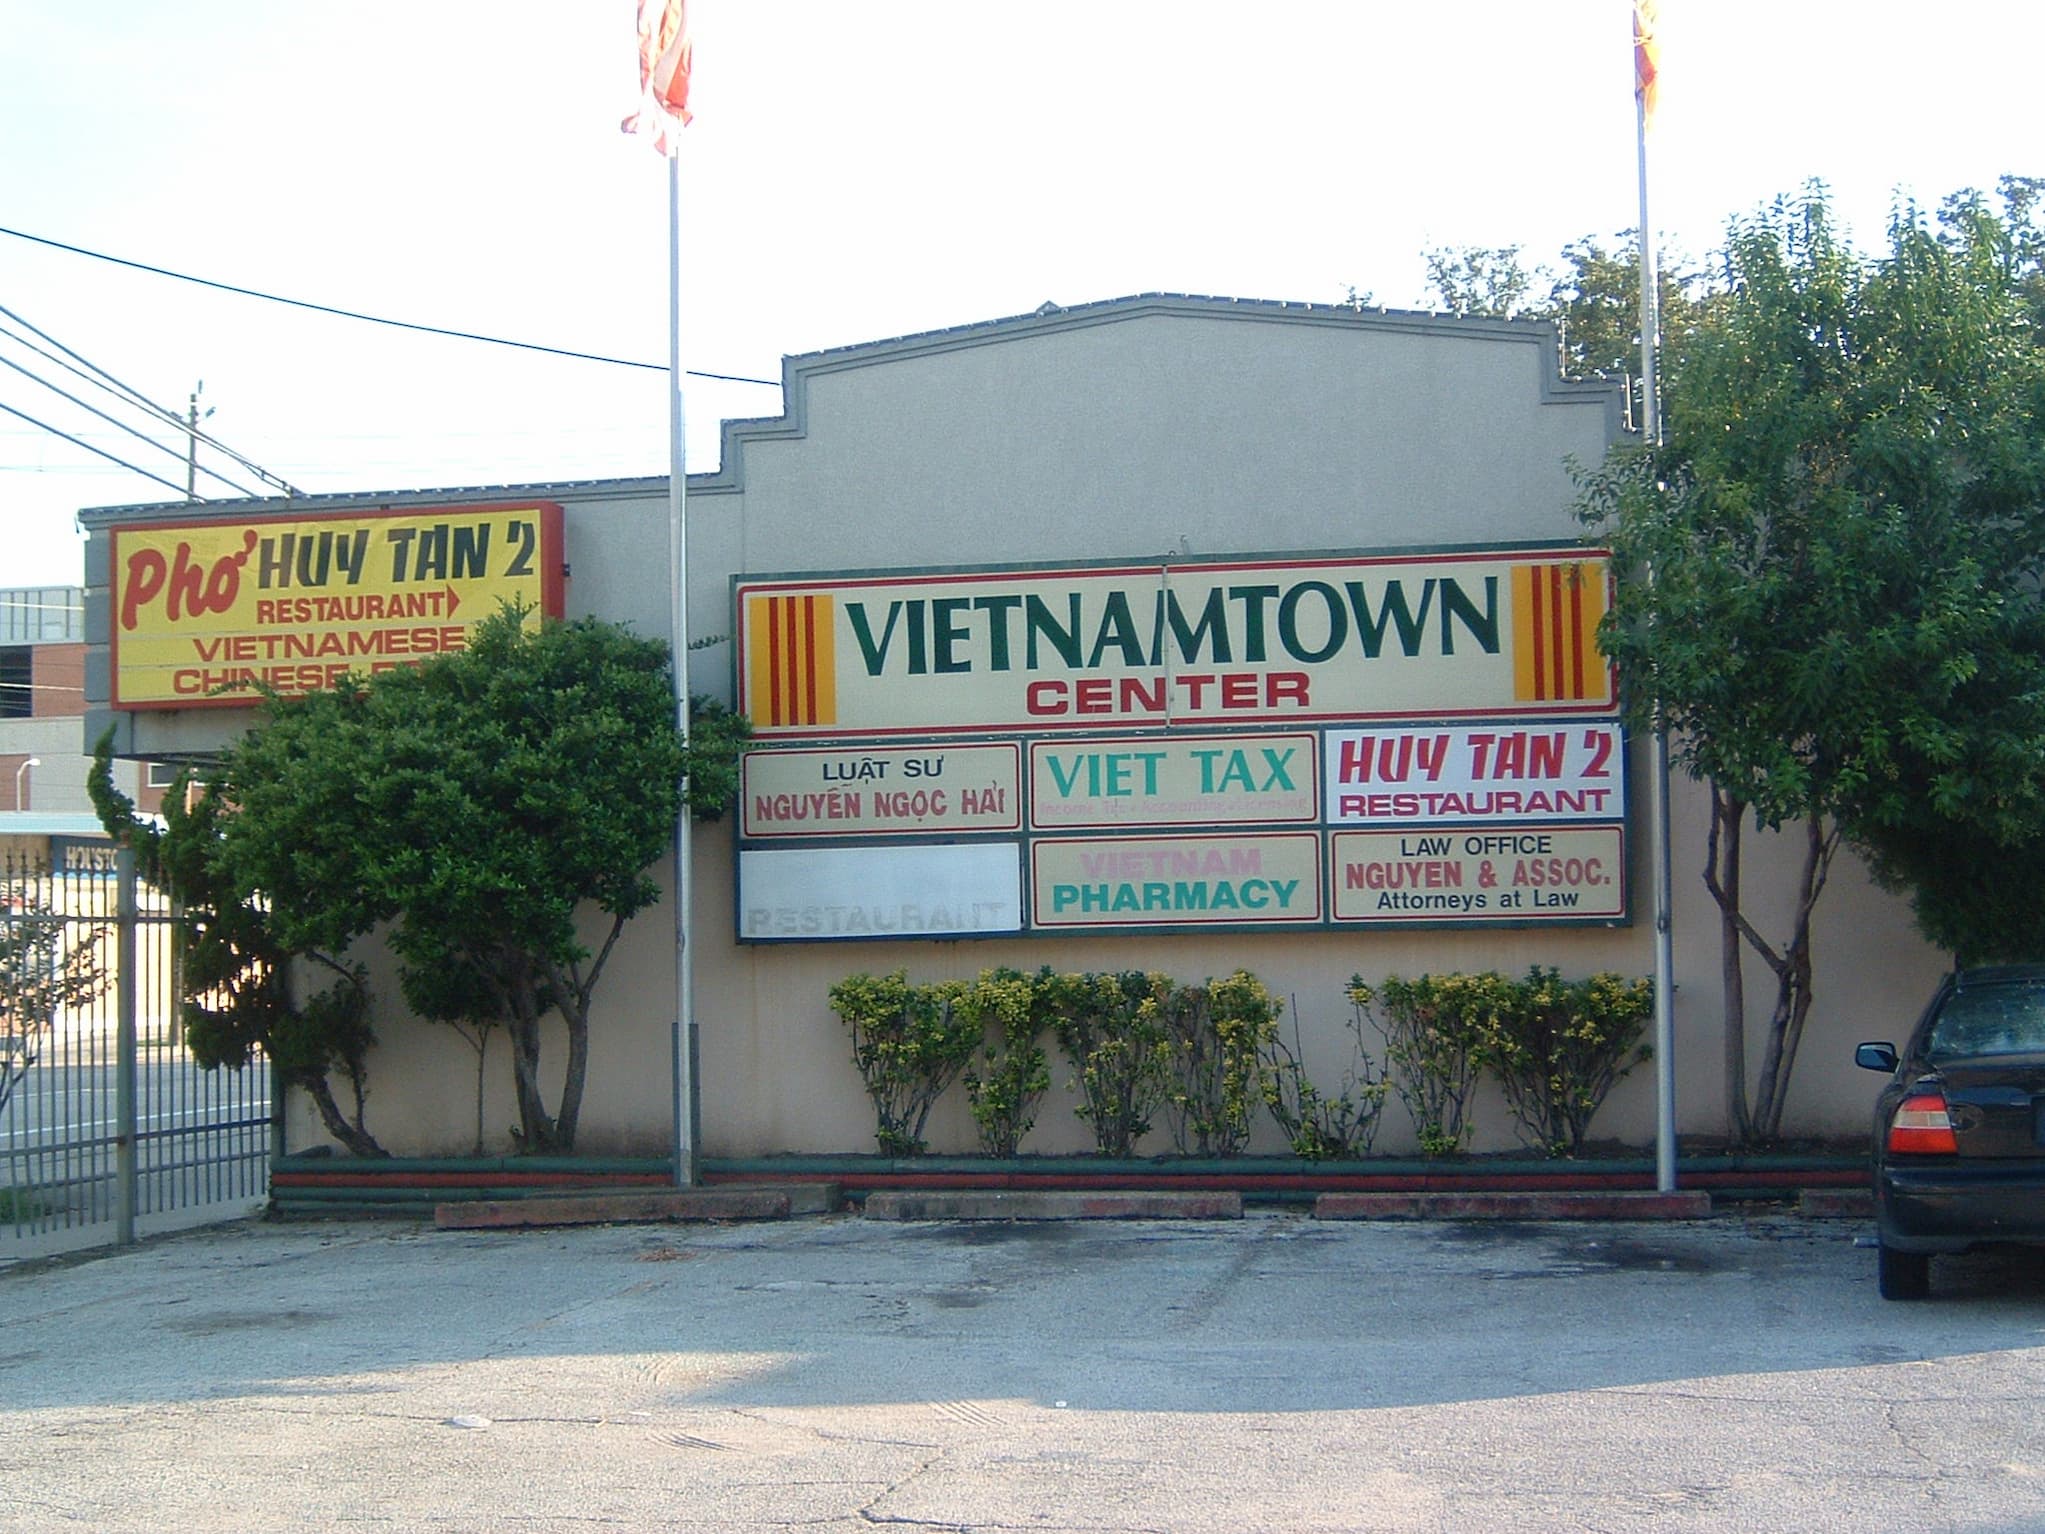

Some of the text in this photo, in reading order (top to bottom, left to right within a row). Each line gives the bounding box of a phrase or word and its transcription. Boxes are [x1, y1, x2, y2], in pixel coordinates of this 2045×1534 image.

[258, 530, 369, 588] HUY
[387, 523, 491, 582] TAN
[504, 520, 536, 577] 2
[257, 592, 446, 624] RESTAURANT
[845, 576, 1500, 677] VIETNAMTOWN
[192, 626, 466, 662] VIETNAMESE
[173, 663, 350, 694] CHINESE
[1026, 672, 1310, 717] CENTER
[823, 757, 890, 784] LUẬT
[1046, 748, 1296, 798] VIET TAX
[1339, 730, 1613, 784] HUY TAN 2
[874, 788, 948, 822] NGỌC
[1340, 789, 1612, 817] RESTAURANT
[1401, 836, 1552, 857] LAW OFFICE
[1080, 848, 1262, 880] VIETNAM
[1346, 858, 1611, 890] NGUYEN & ASSOC.
[1053, 879, 1299, 913] PHARMACY
[1377, 889, 1579, 912] Attorneys at Law
